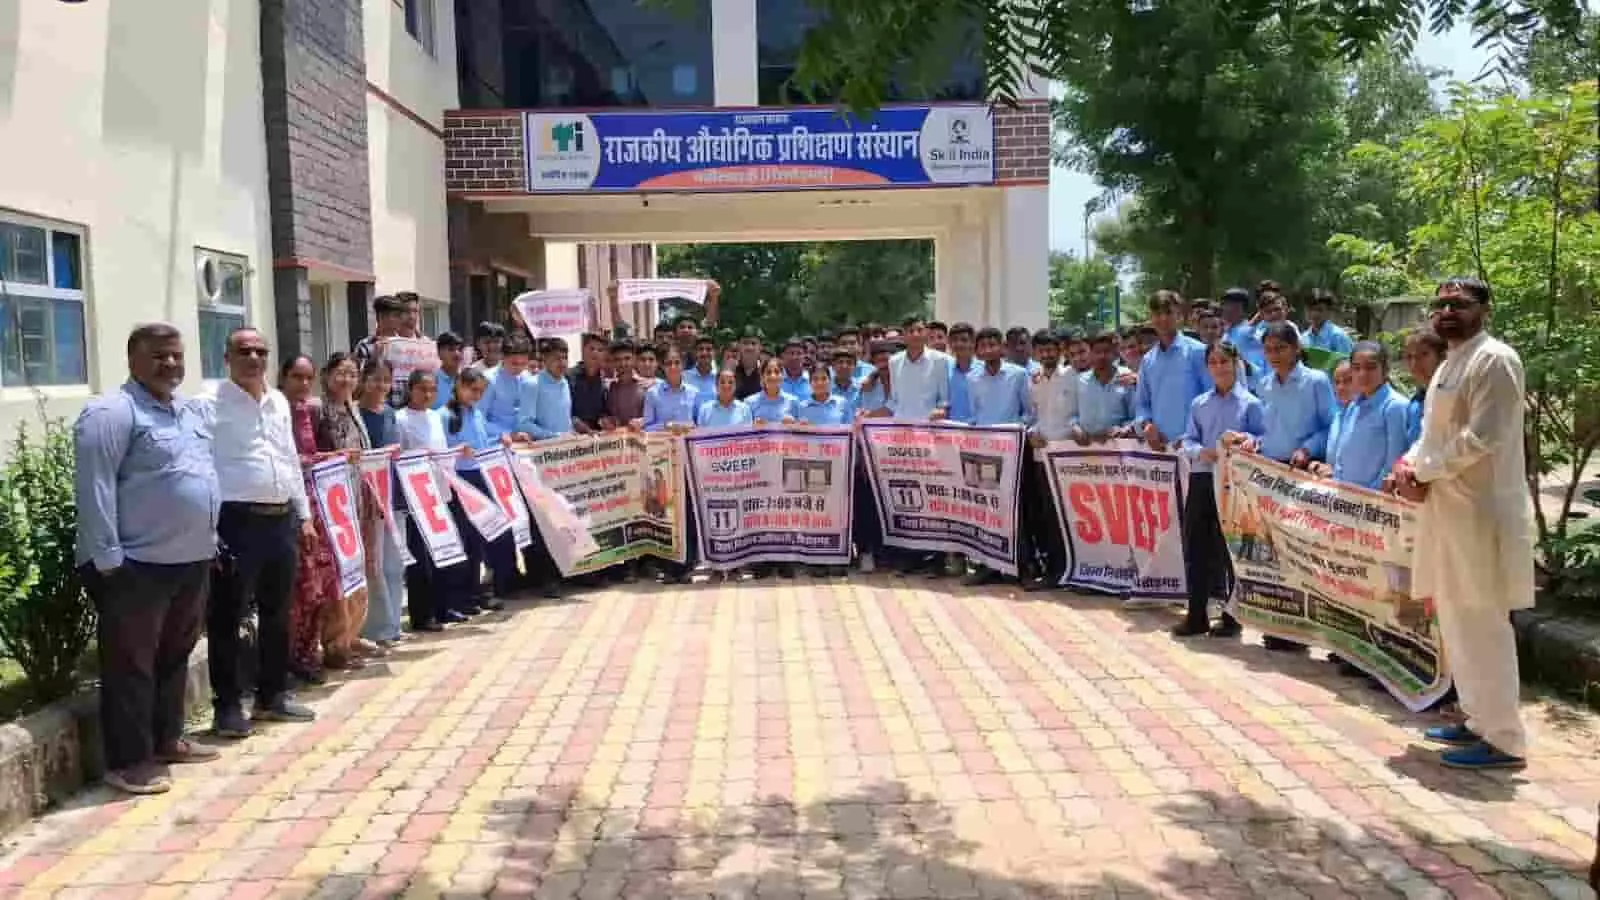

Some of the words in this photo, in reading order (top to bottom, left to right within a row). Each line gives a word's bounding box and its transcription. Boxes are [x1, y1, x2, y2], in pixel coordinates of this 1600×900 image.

[604, 128, 683, 164] राजकीय
[686, 125, 775, 163] औद्योगिक
[777, 126, 854, 164] प्रशिक्षण
[855, 124, 920, 160] संस्थान
[898, 488, 913, 504] 11
[327, 483, 357, 560] S
[408, 471, 449, 534] E
[714, 511, 731, 528] 11
